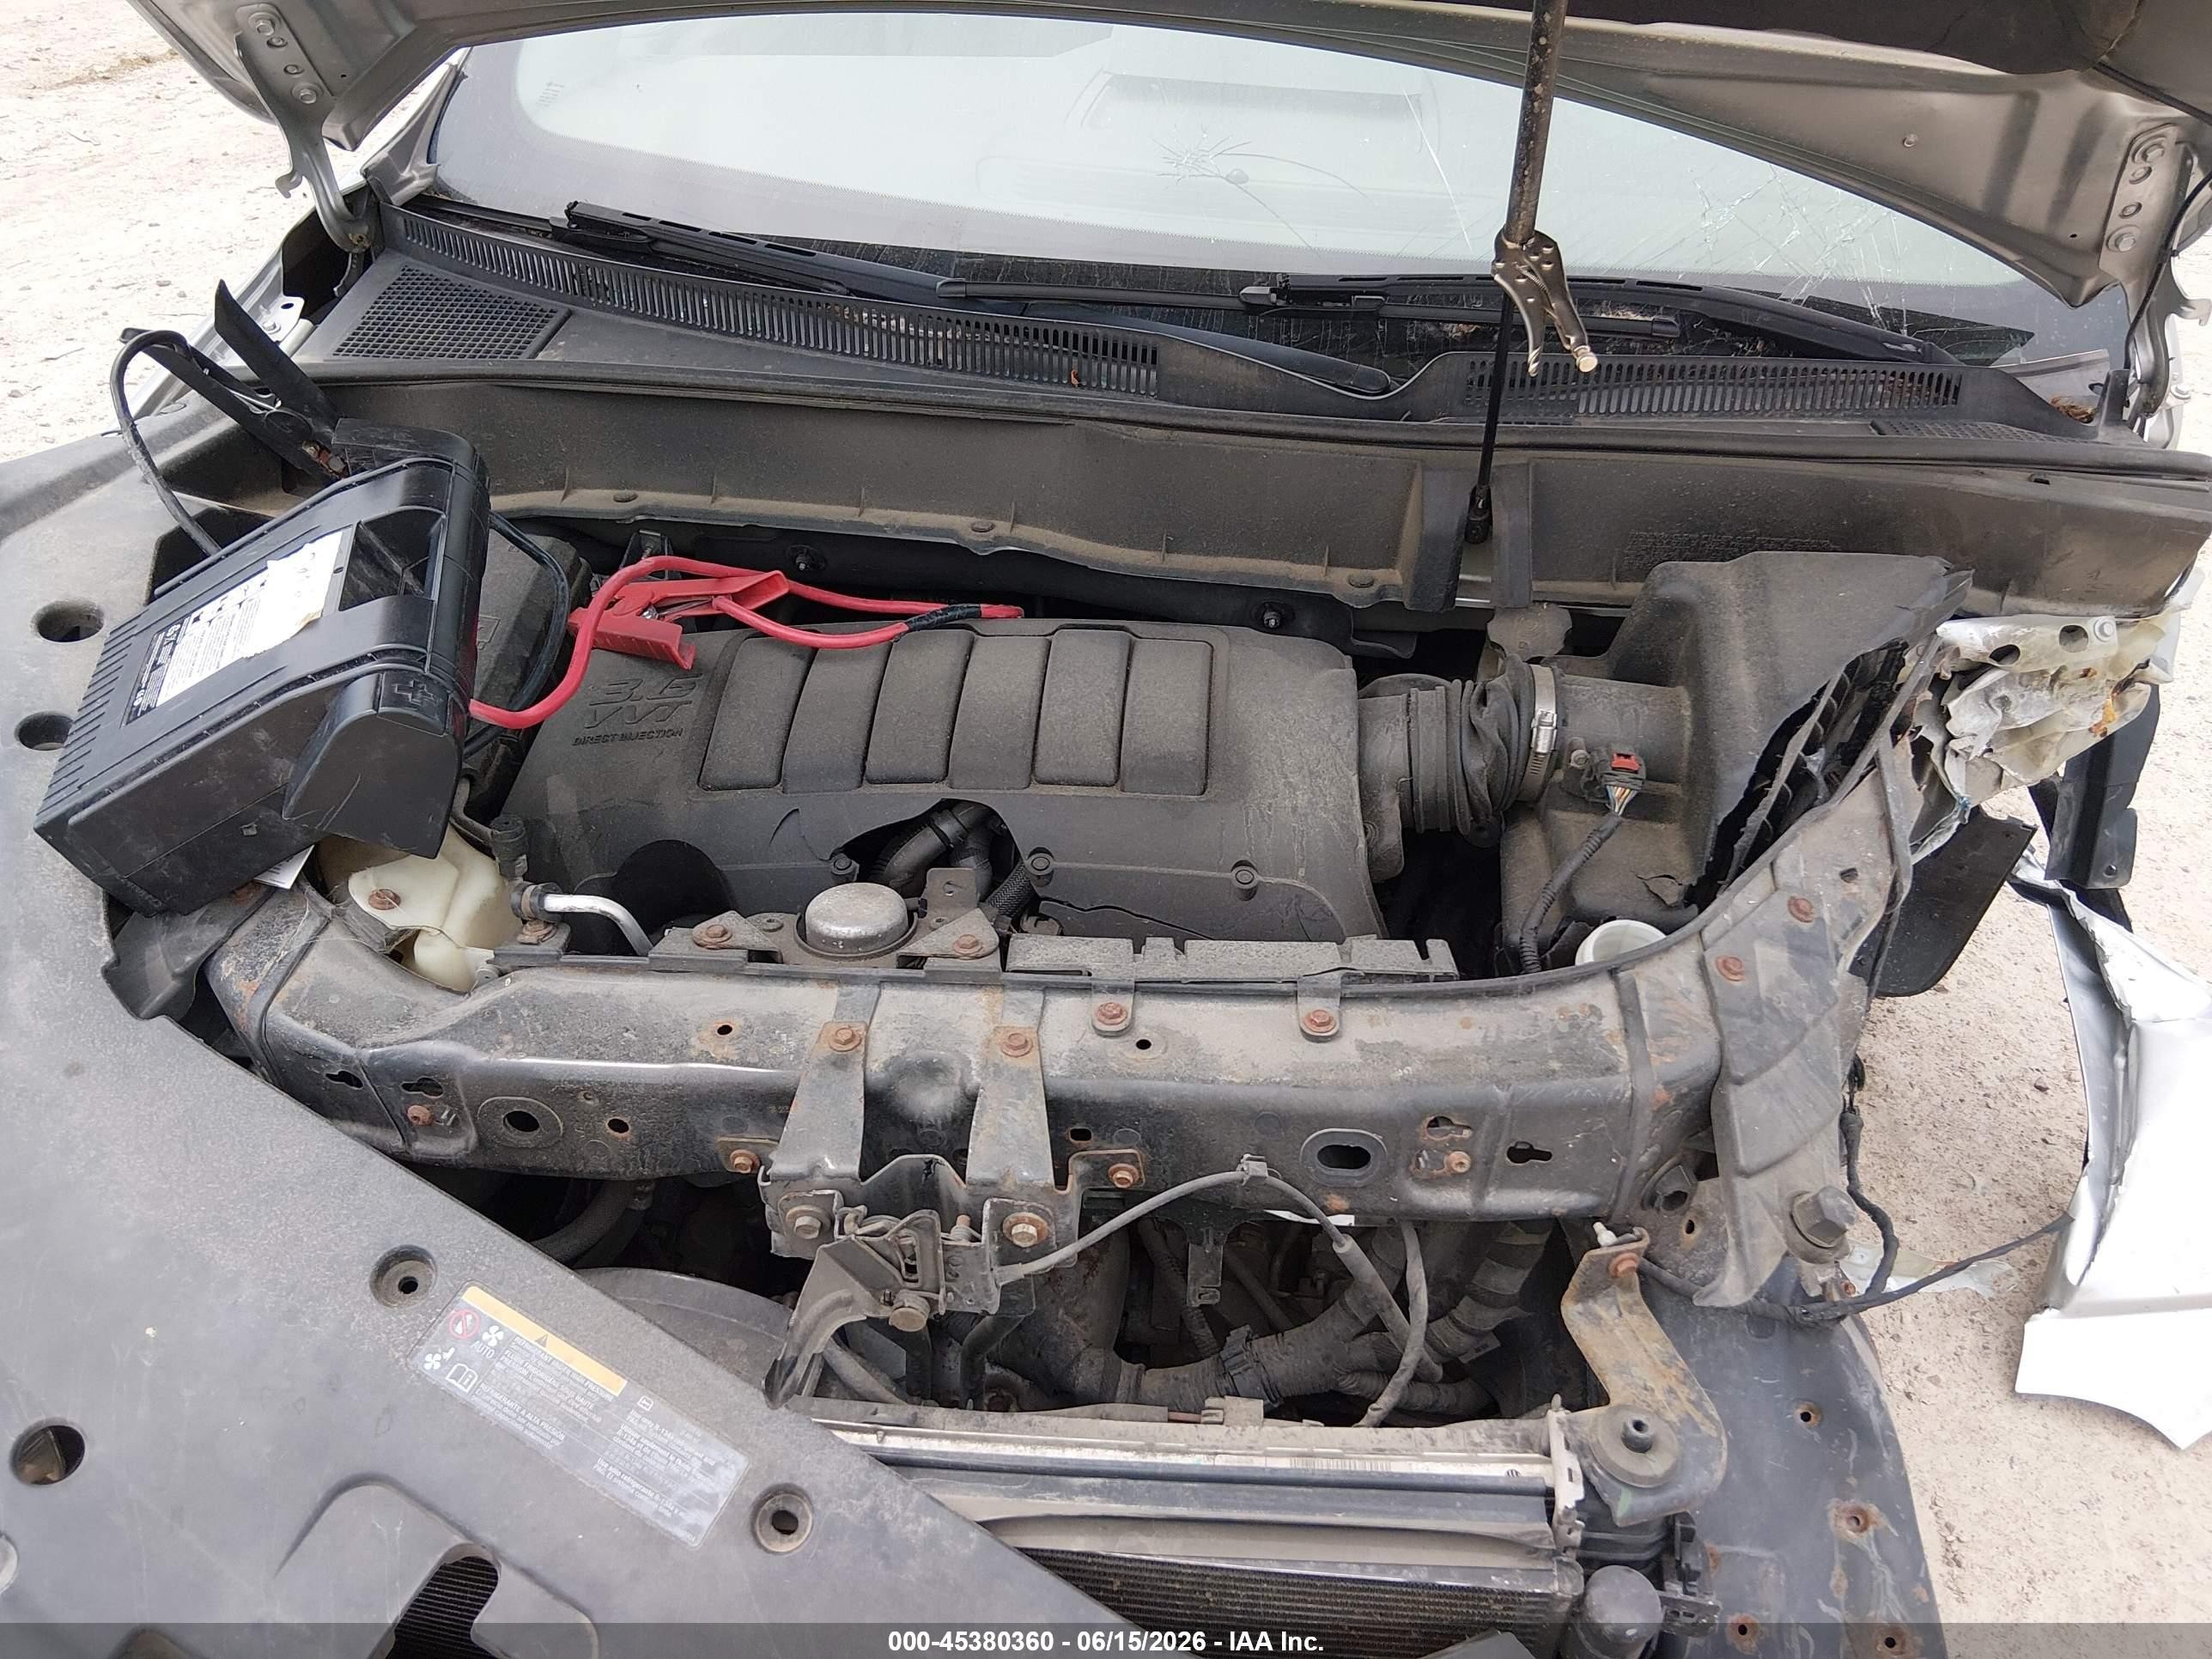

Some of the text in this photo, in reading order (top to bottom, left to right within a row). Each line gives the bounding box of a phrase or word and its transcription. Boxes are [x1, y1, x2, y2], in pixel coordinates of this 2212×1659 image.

[590, 673, 702, 706] 3.6
[584, 700, 693, 729] VVT
[572, 728, 684, 746] DIRECT INJECTION
[471, 1340, 495, 1359] AUTO
[526, 1411, 541, 1424] ALTA
[620, 1472, 655, 1498] refrigerante
